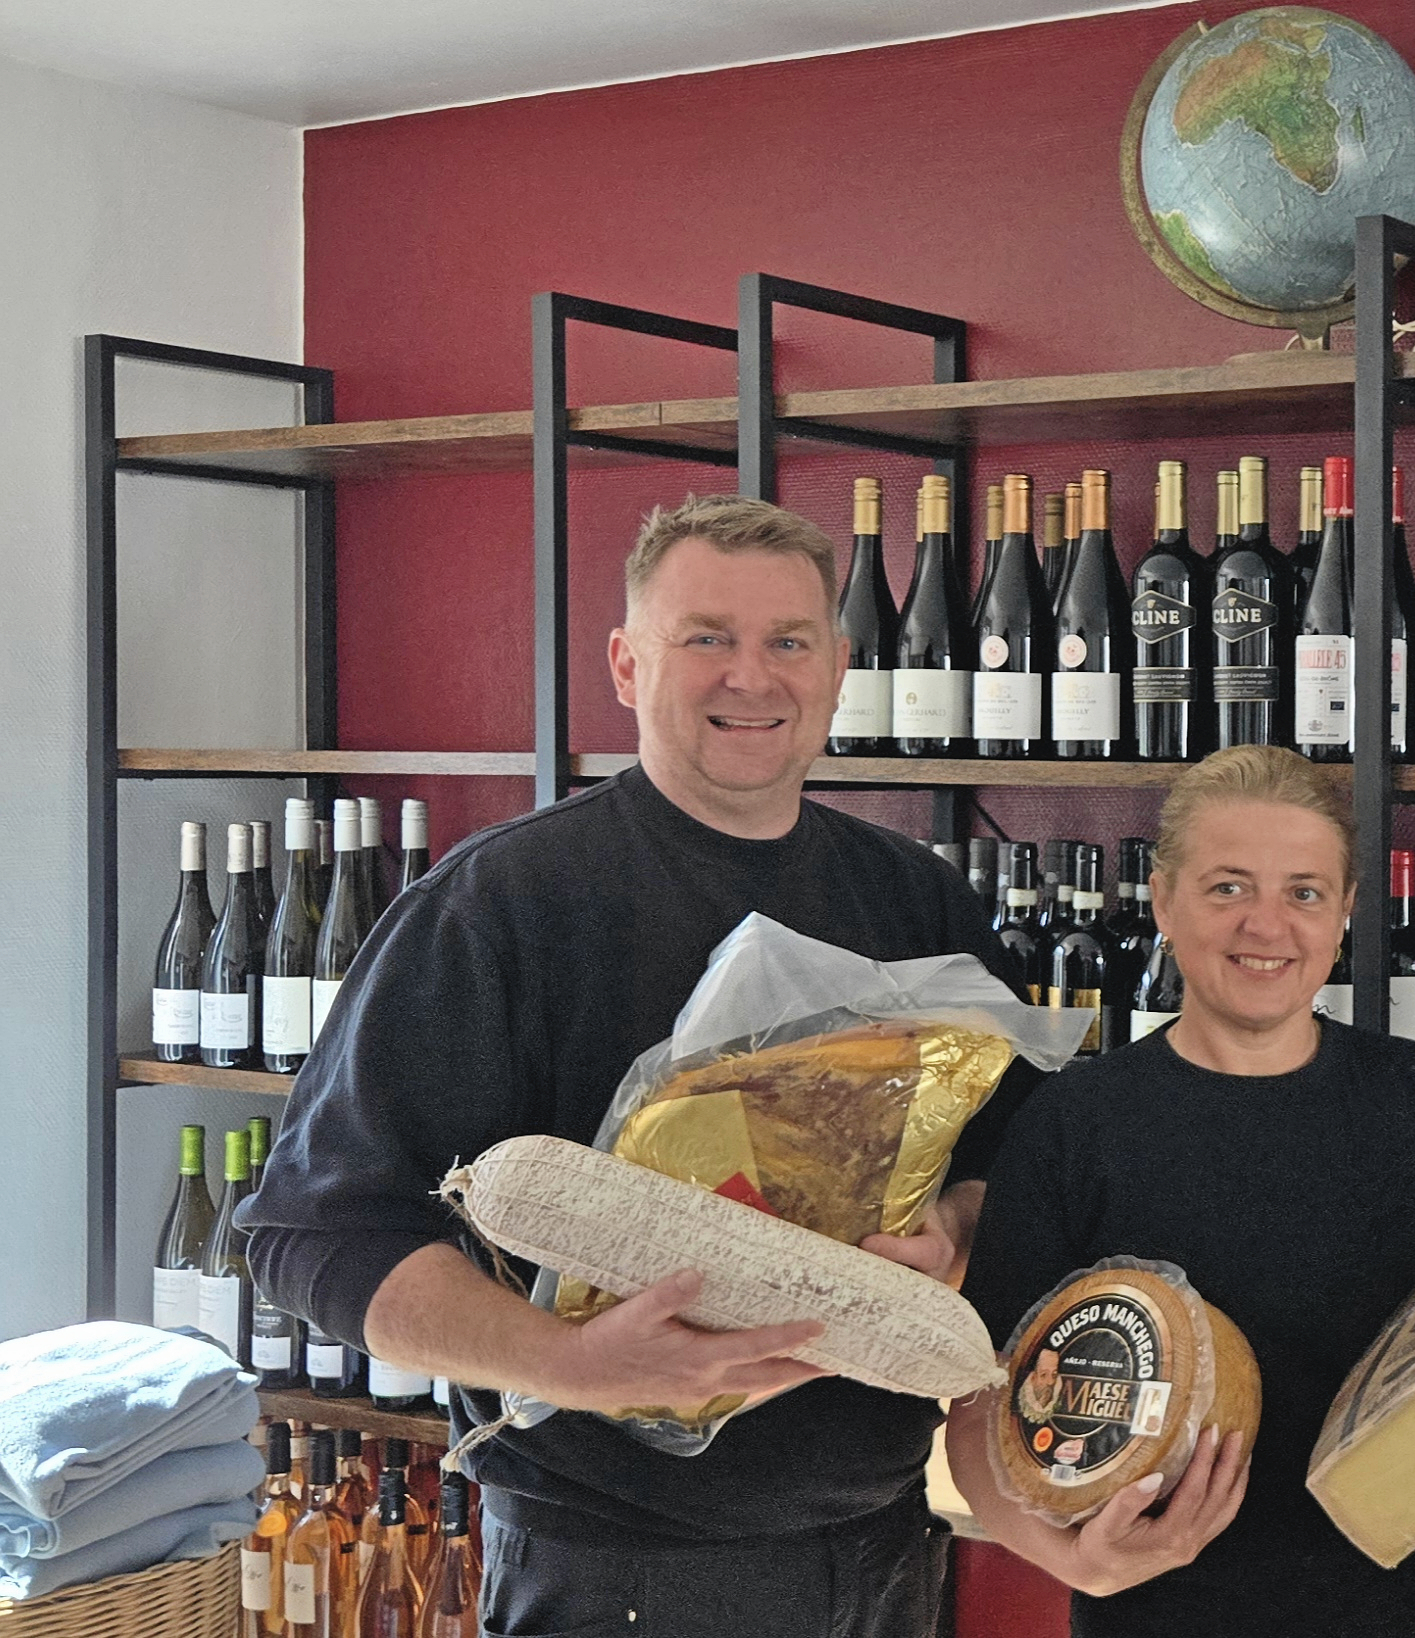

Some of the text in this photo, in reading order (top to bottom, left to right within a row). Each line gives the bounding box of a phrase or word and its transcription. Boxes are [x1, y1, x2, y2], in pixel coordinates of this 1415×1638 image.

[1132, 608, 1180, 626] CLINE
[1213, 607, 1262, 624] CLINE
[1334, 649, 1347, 669] 45
[1050, 1303, 1154, 1379] QUESO MANCHEGO
